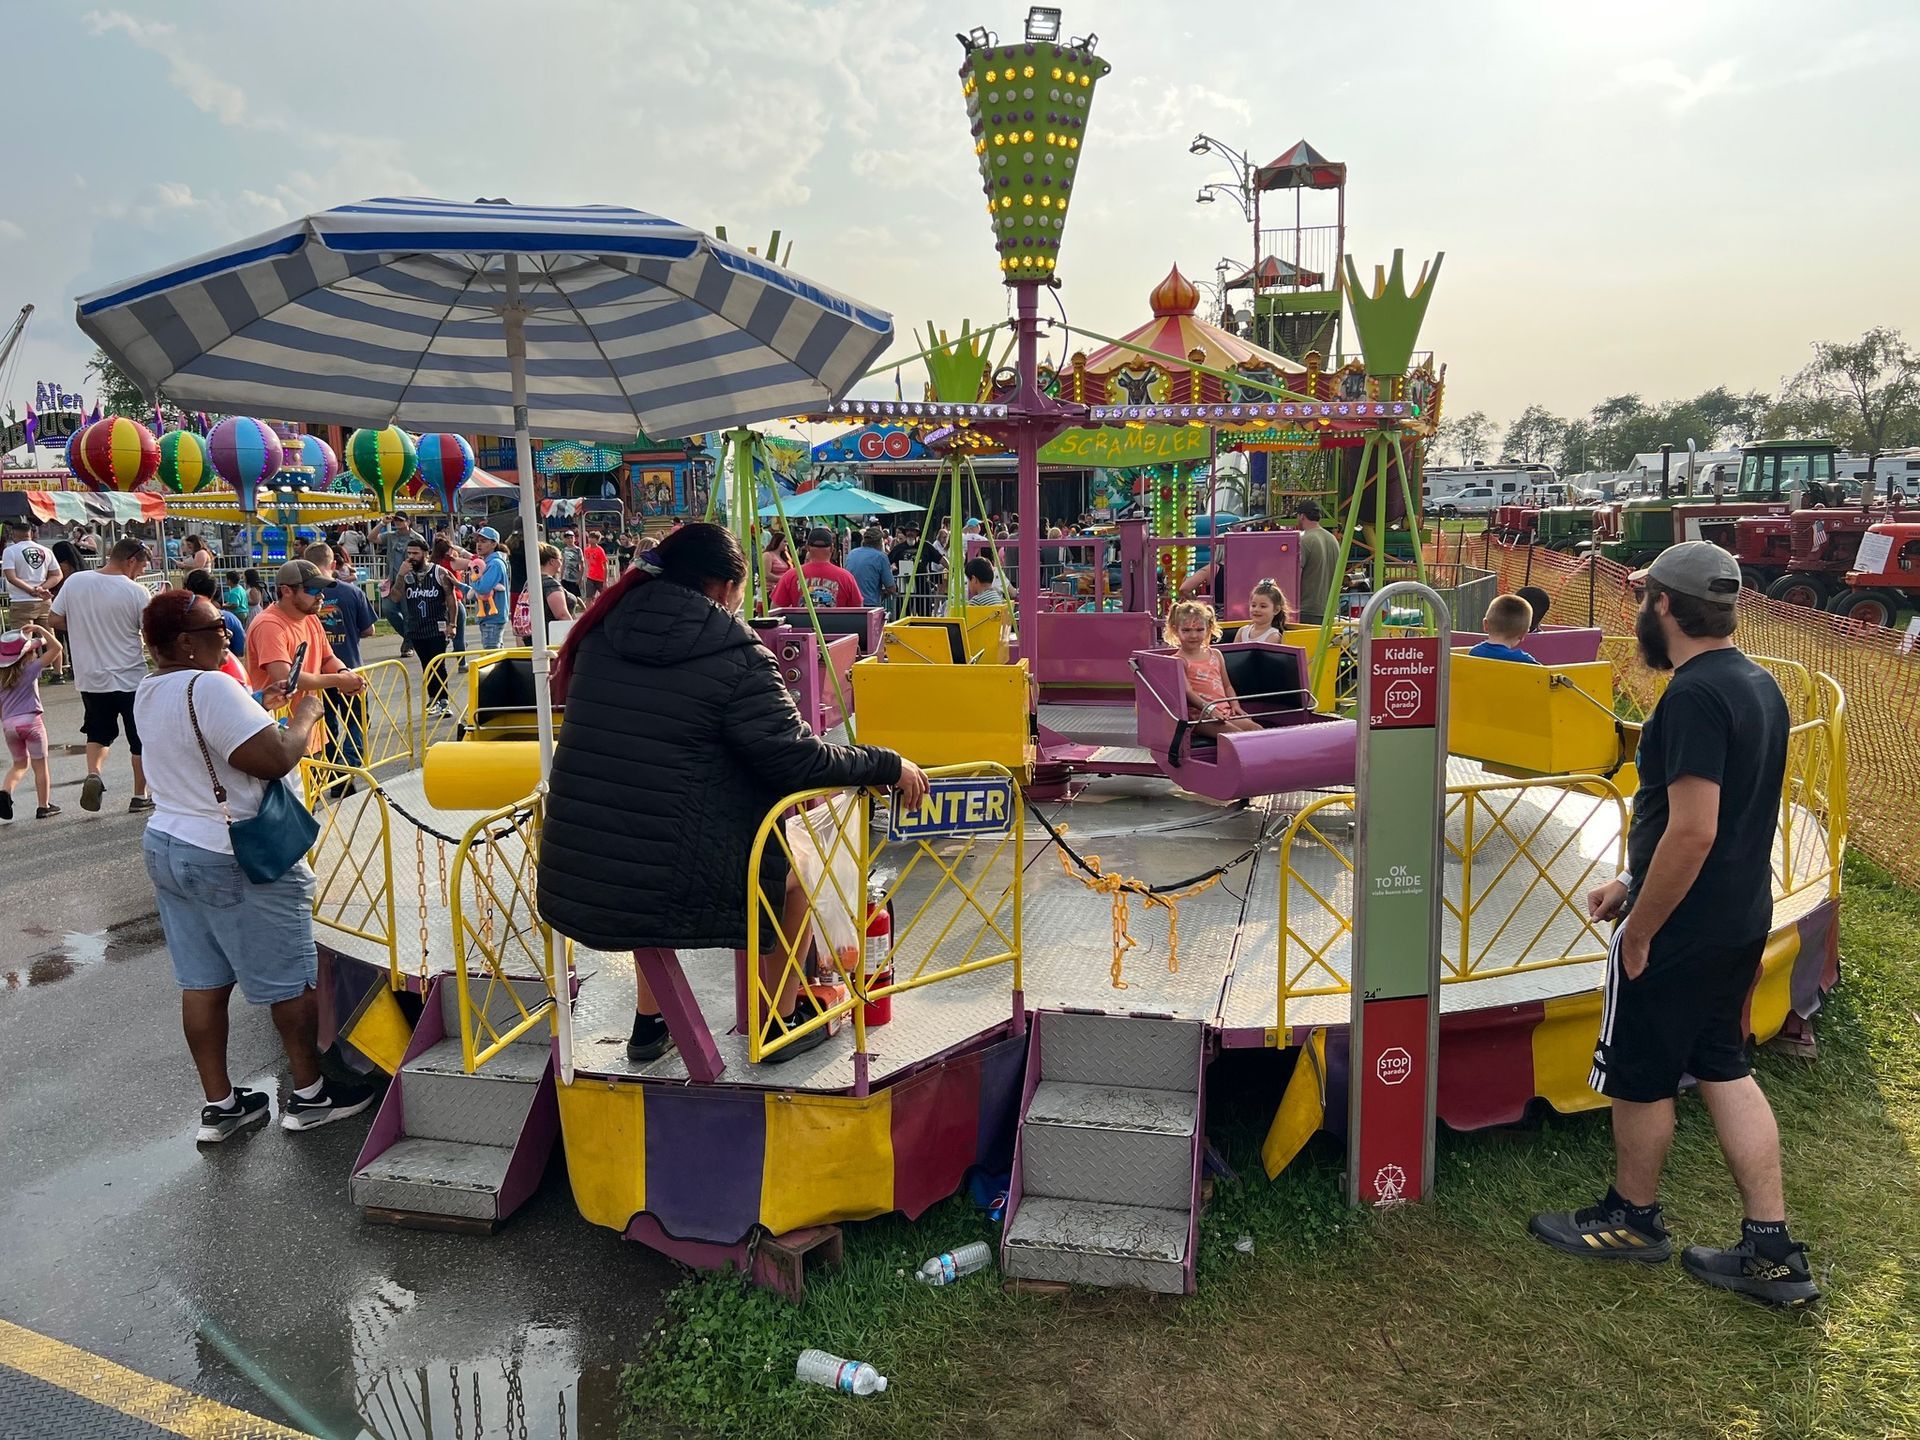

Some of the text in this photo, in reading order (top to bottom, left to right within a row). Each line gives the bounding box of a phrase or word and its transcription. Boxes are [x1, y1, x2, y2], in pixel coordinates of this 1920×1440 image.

[36, 381, 83, 411] Alien
[858, 432, 911, 459] GO
[1060, 430, 1201, 459] SCRAMBLER
[417, 600, 427, 618] 1
[1385, 648, 1424, 660] Kiddie
[1373, 662, 1435, 675] Scrambler
[1388, 691, 1418, 701] STOP
[1391, 701, 1415, 710] parada
[1389, 865, 1408, 877] OK
[1375, 875, 1421, 889] TO RIDE
[1380, 1057, 1408, 1069] STOP
[1382, 1068, 1405, 1077] parada
